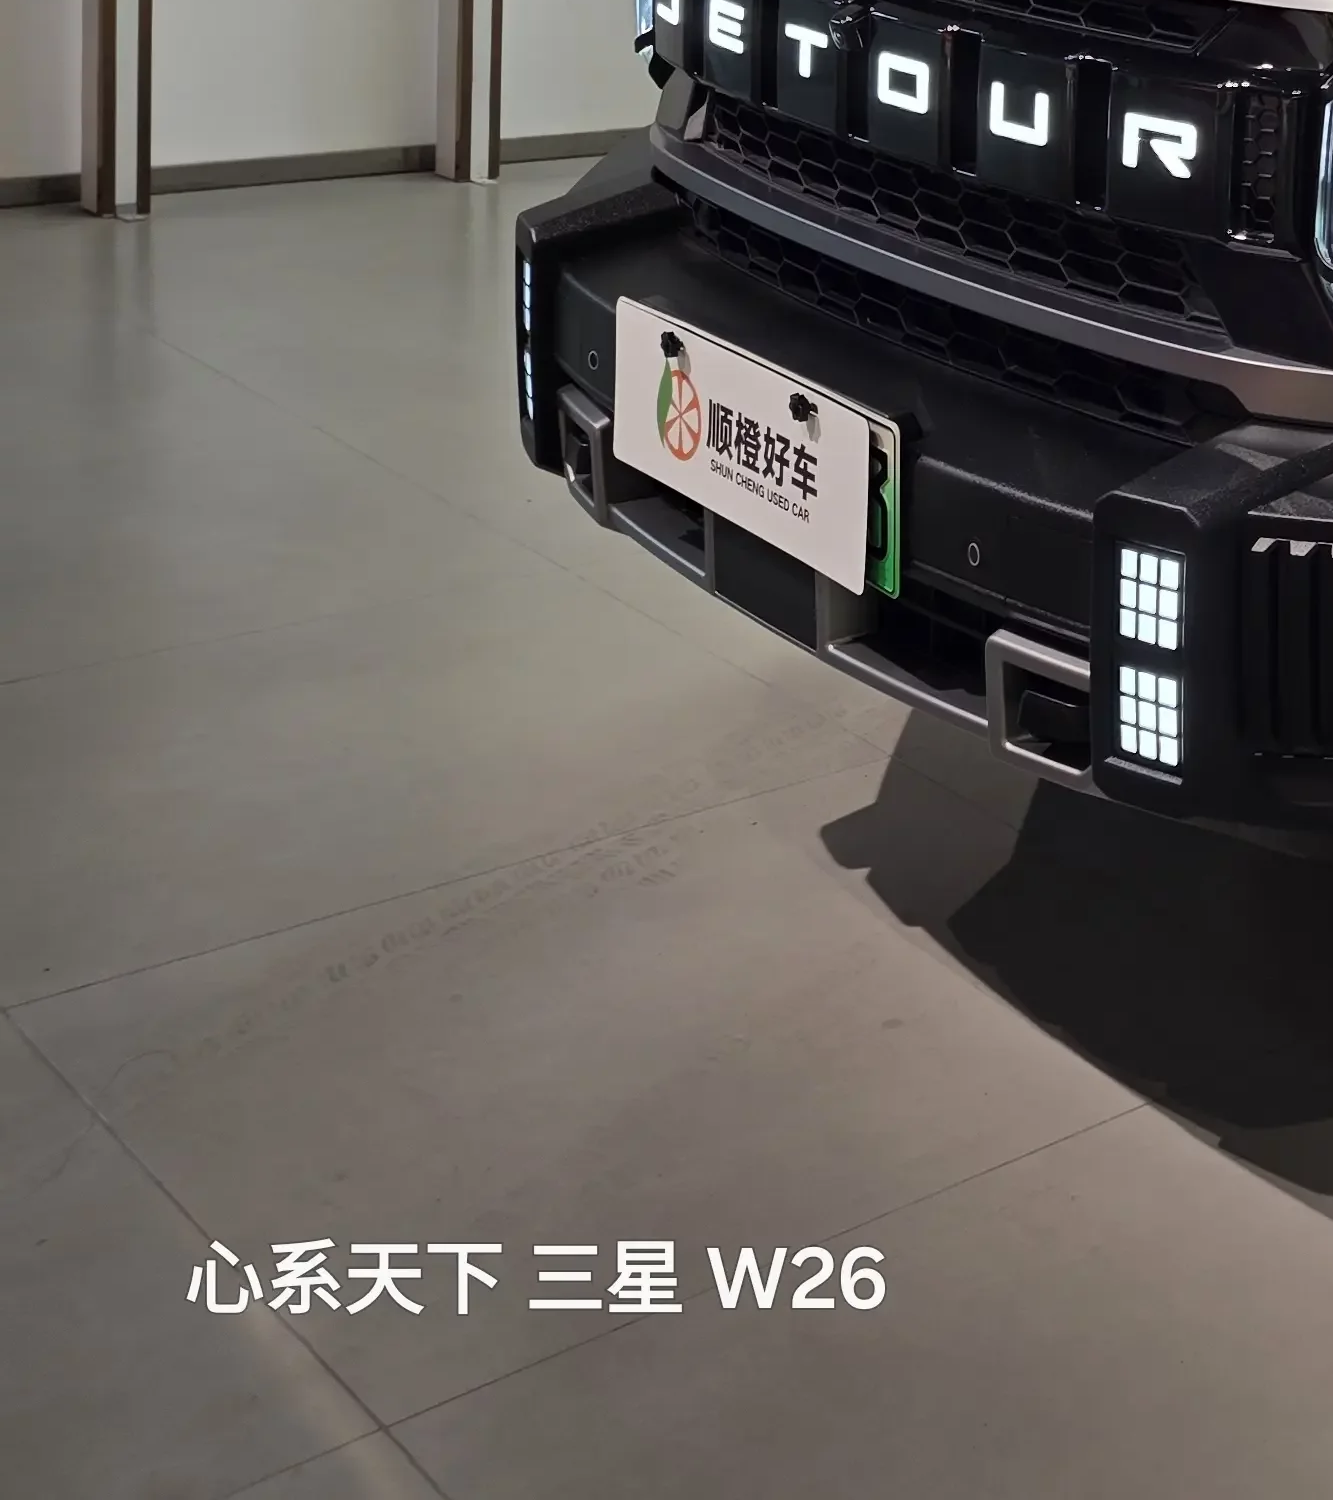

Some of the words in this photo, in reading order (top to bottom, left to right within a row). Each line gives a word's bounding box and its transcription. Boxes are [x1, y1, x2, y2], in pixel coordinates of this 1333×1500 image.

[706, 398, 818, 501] 顺橙好车
[710, 459, 734, 482] SHUN
[735, 472, 765, 498] CHENG
[767, 488, 790, 512] USED
[791, 503, 810, 524] CAR
